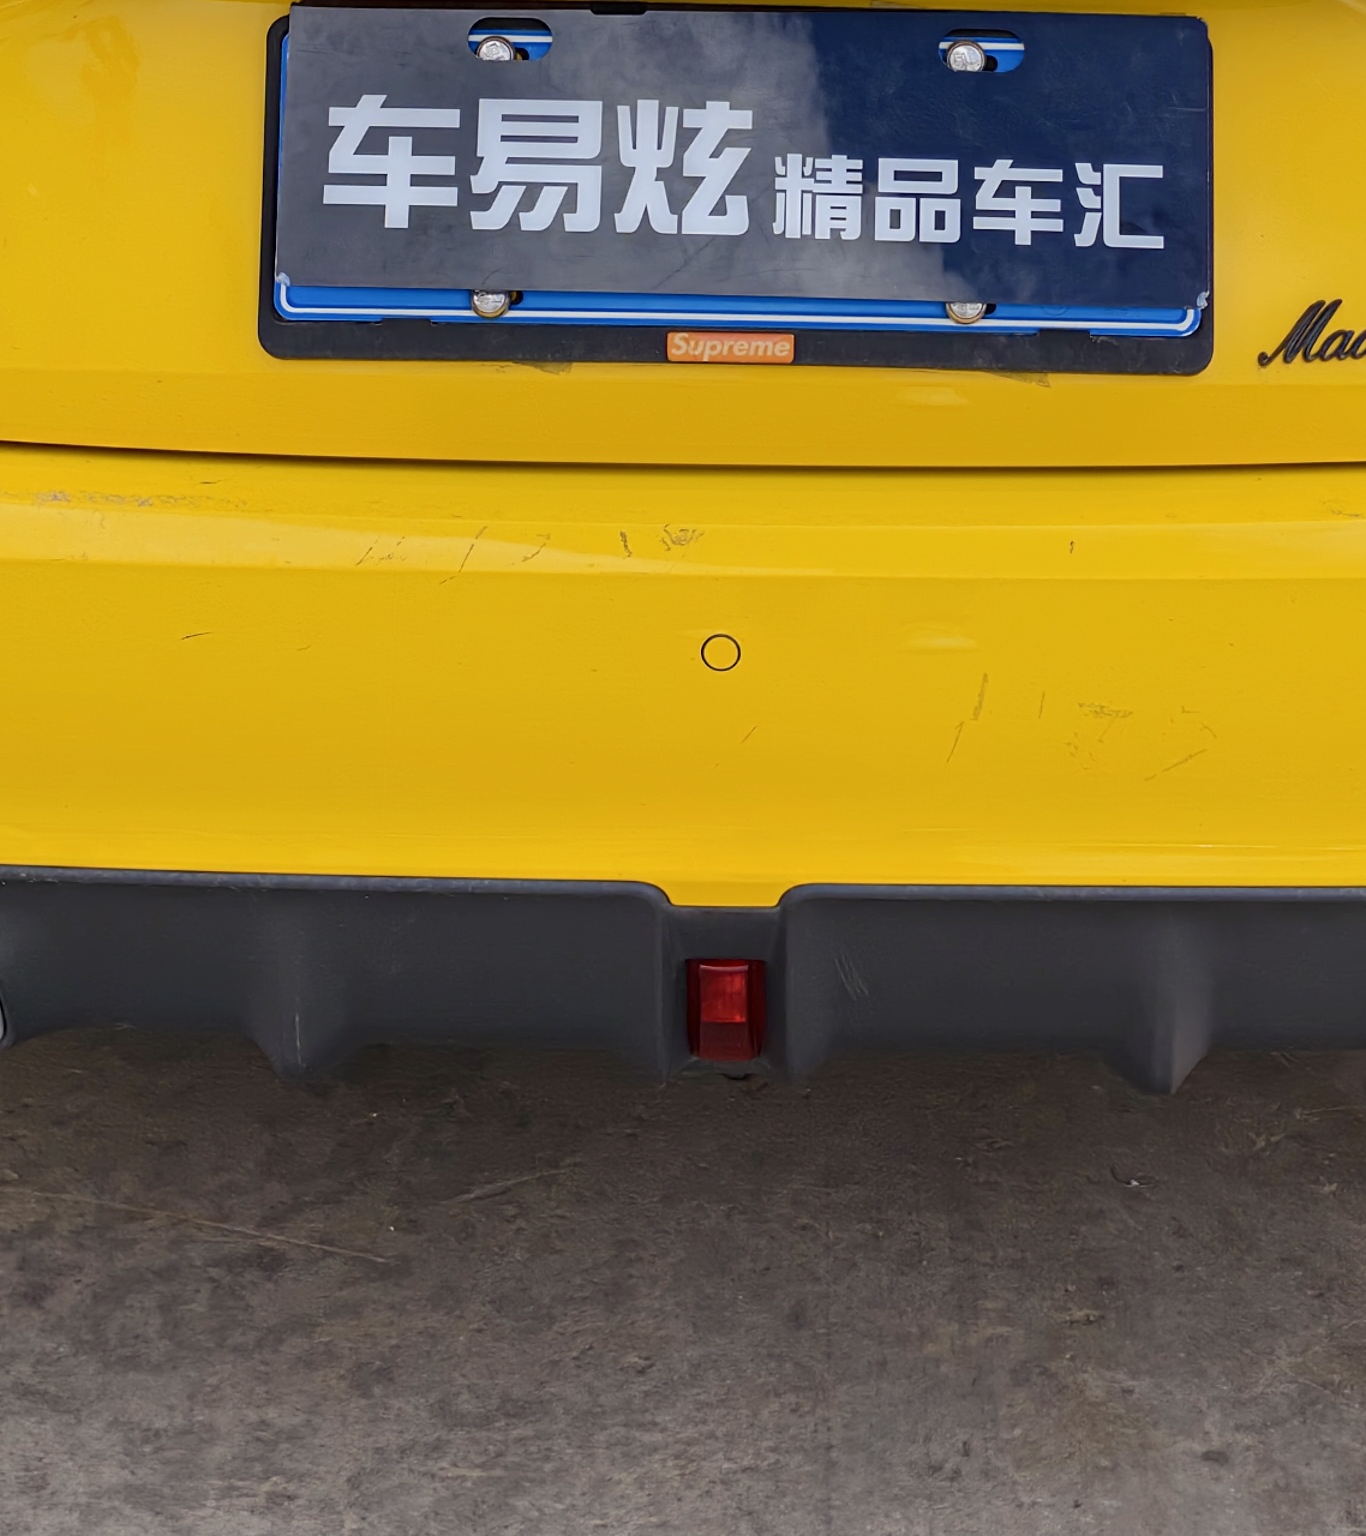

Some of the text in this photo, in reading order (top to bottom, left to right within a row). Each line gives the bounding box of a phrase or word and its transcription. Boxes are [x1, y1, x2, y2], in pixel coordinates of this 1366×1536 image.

[322, 94, 1165, 250] 车易炫 精品车汇
[670, 332, 791, 362] Supreme
